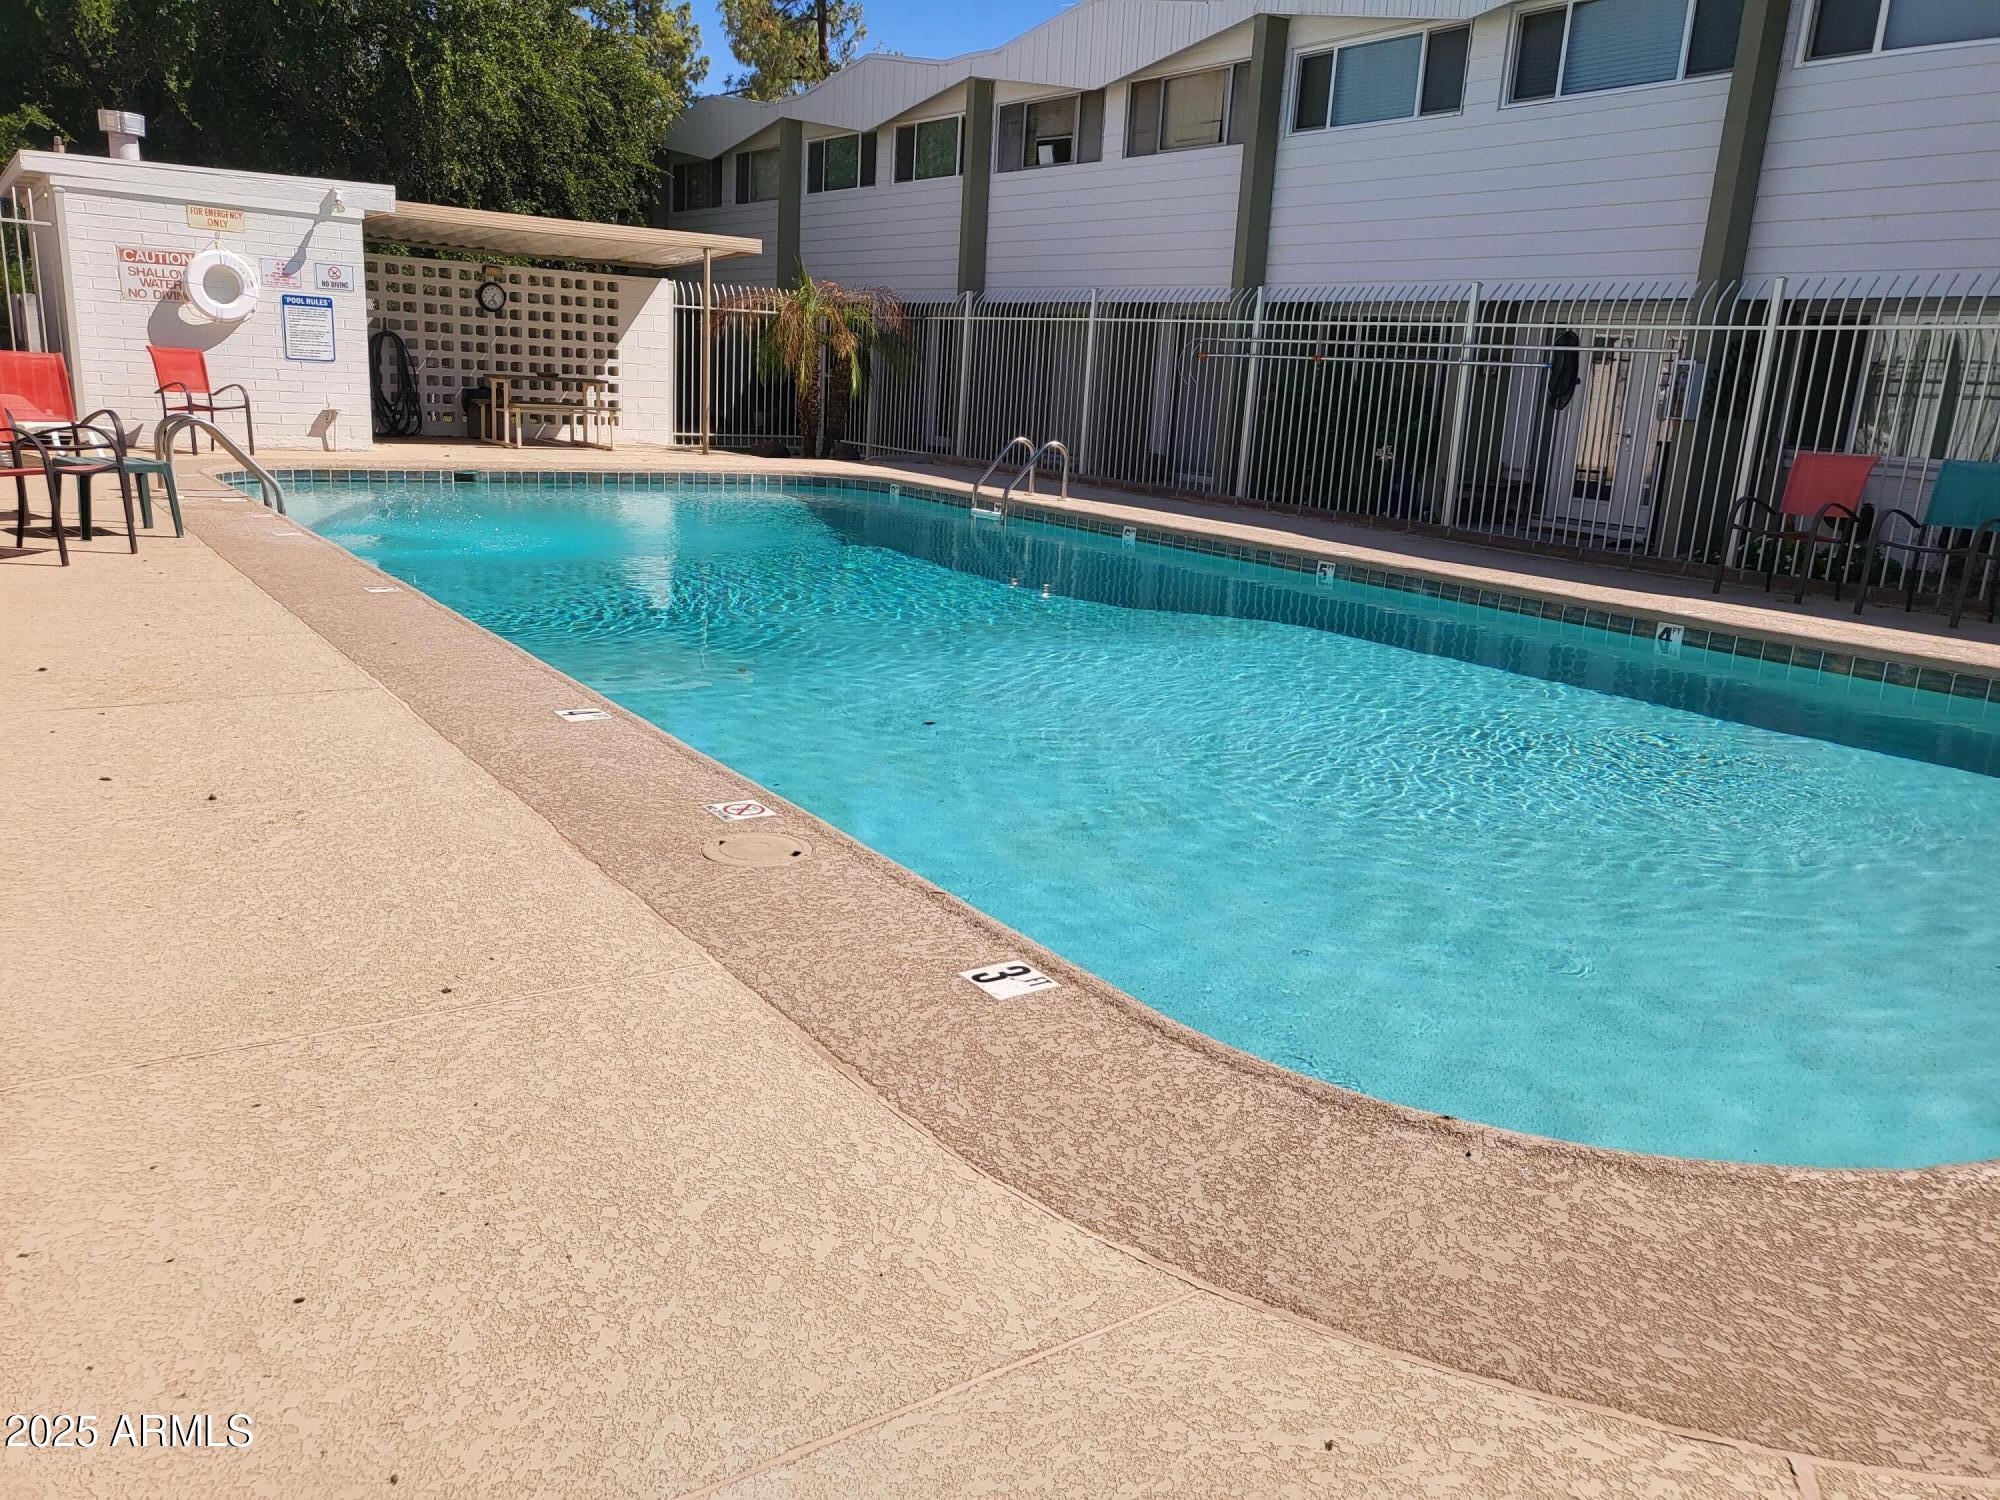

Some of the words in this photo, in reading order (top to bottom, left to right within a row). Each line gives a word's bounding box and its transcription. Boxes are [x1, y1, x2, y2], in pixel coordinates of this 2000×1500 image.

[190, 206, 203, 216] FOR
[204, 208, 242, 220] EMERGENCY
[207, 218, 228, 228] ONLY
[123, 249, 193, 265] CAUTION
[139, 278, 182, 290] WATER
[321, 279, 330, 287] NO
[330, 280, 349, 289] DIVING
[128, 288, 147, 299] NO
[153, 290, 190, 301] DIVIN
[1658, 627, 1672, 642] 4
[971, 965, 1031, 983] 3
